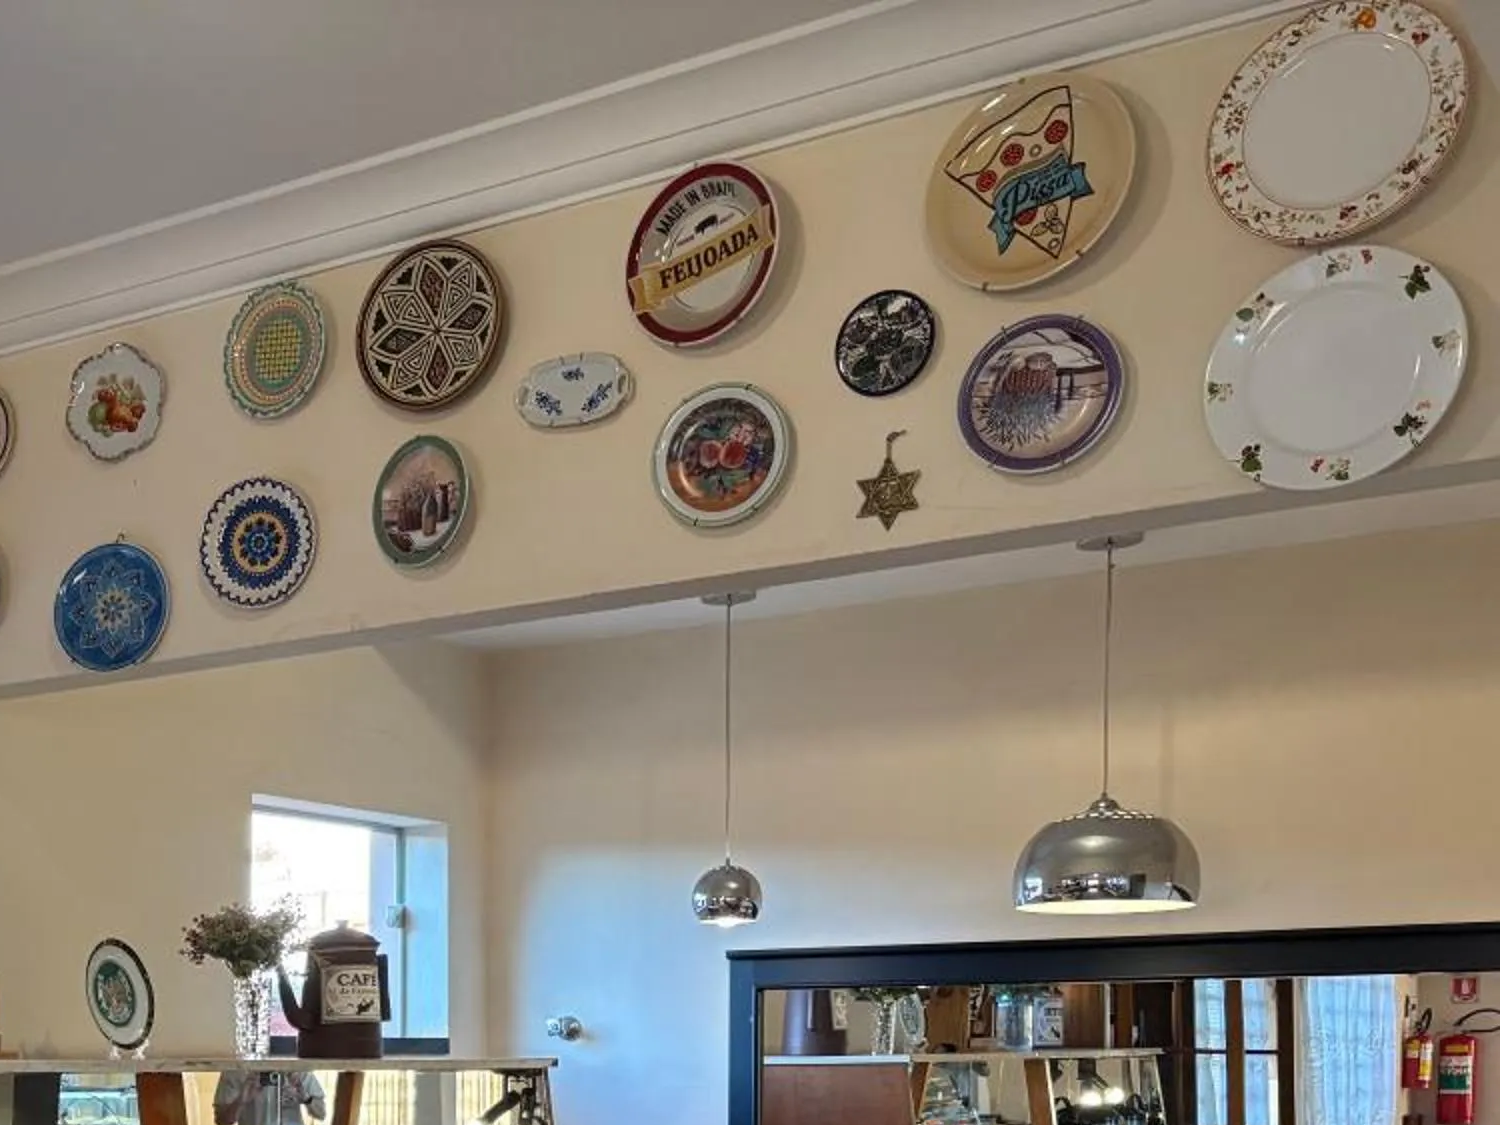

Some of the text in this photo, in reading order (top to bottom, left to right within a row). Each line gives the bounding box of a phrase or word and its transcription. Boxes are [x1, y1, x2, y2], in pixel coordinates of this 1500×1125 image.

[656, 201, 686, 236] MADE
[684, 189, 700, 206] IN
[659, 223, 758, 288] FEIJOADA
